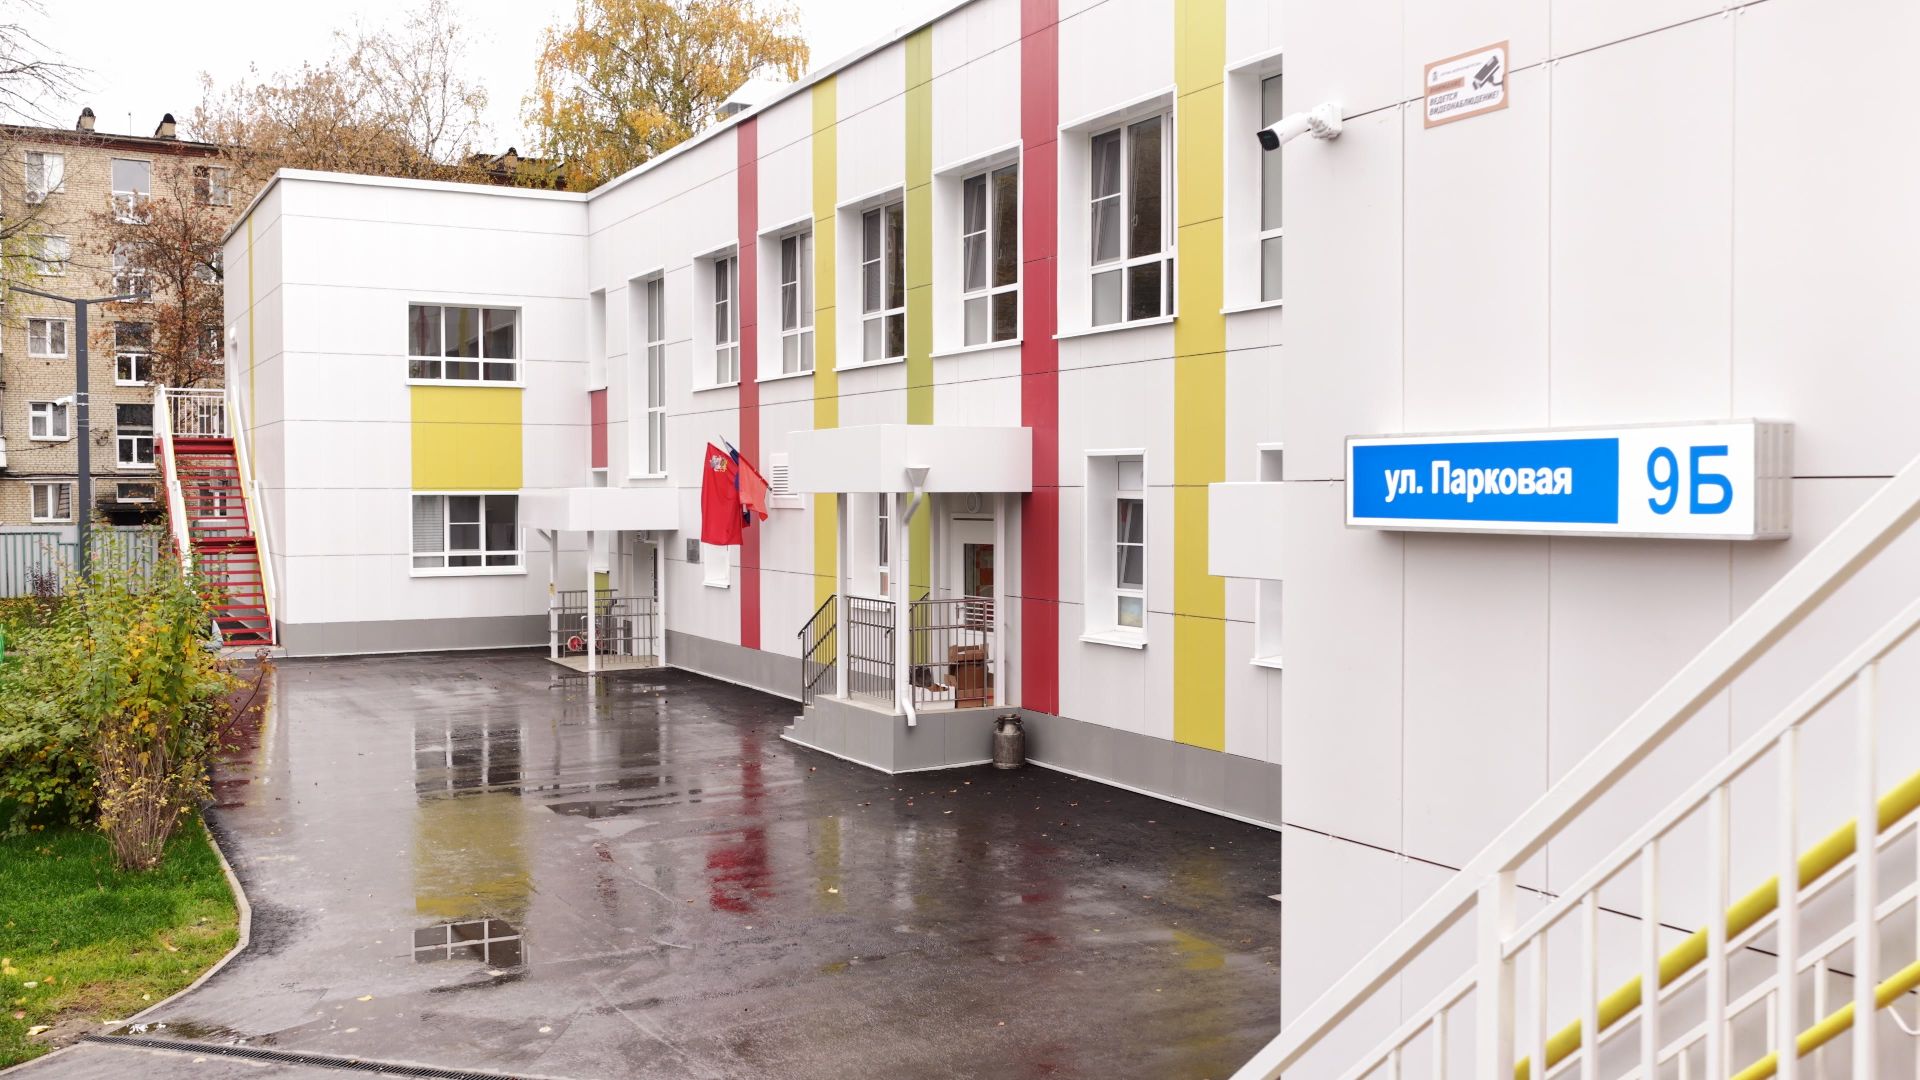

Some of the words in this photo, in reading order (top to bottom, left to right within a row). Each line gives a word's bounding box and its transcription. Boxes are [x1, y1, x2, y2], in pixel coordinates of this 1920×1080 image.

[1384, 467, 1423, 503] ул.
[1431, 460, 1573, 503] Парковая
[1646, 444, 1734, 516] 9Б
